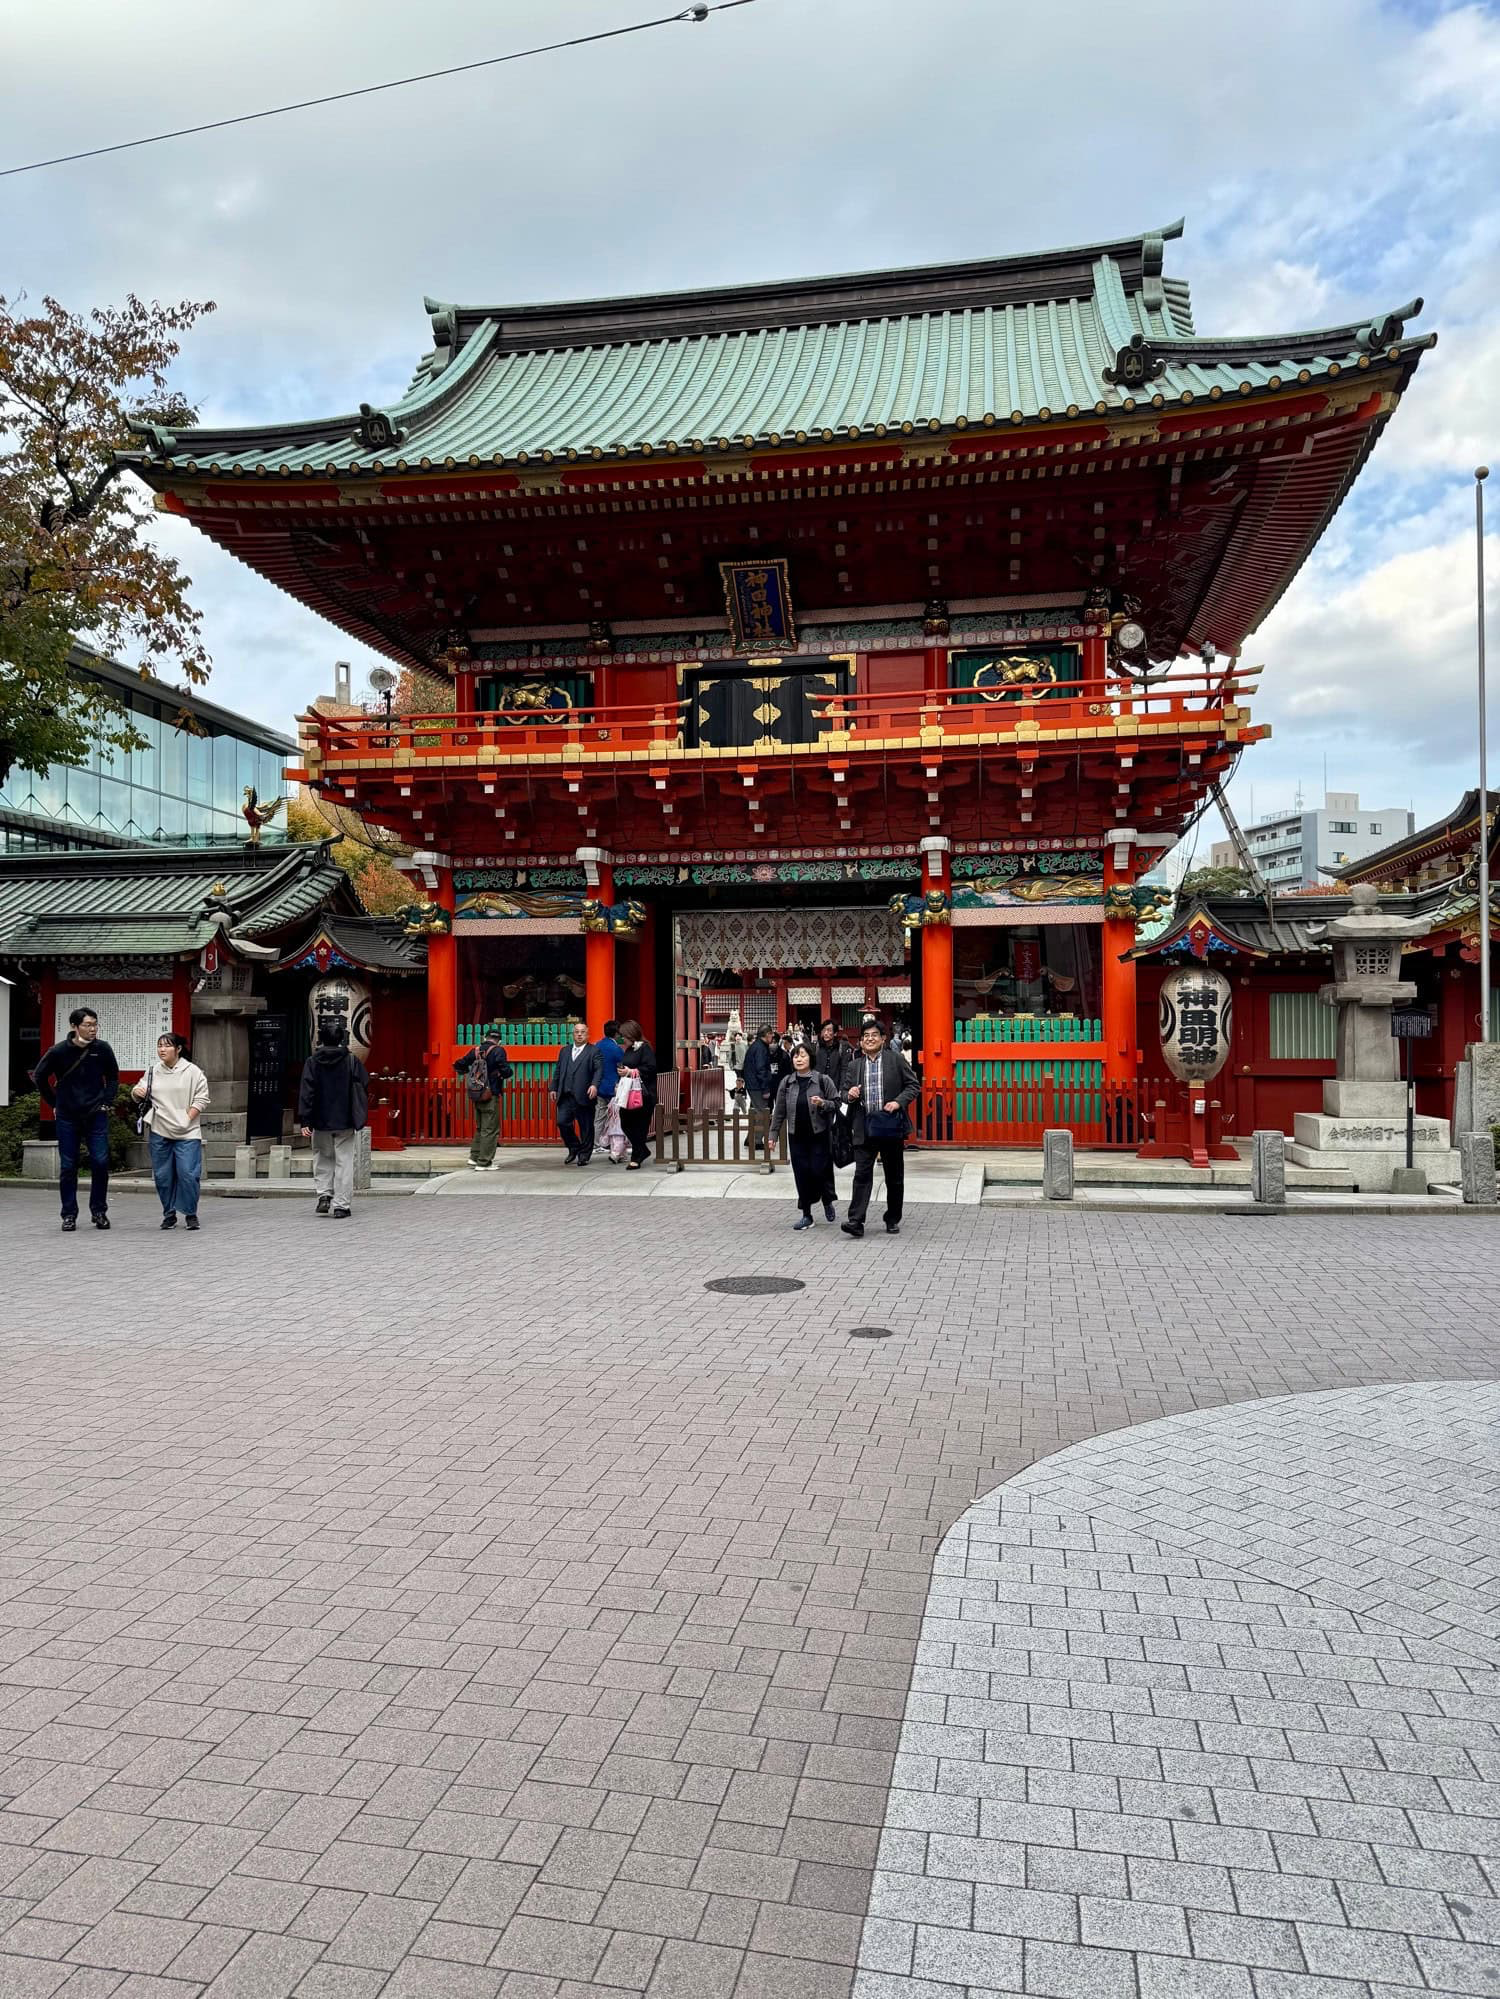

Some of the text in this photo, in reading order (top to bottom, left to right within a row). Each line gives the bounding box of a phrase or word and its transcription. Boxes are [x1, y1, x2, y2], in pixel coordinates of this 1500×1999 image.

[745, 570, 776, 637] 神田神社
[1177, 986, 1218, 1065] 神田明神
